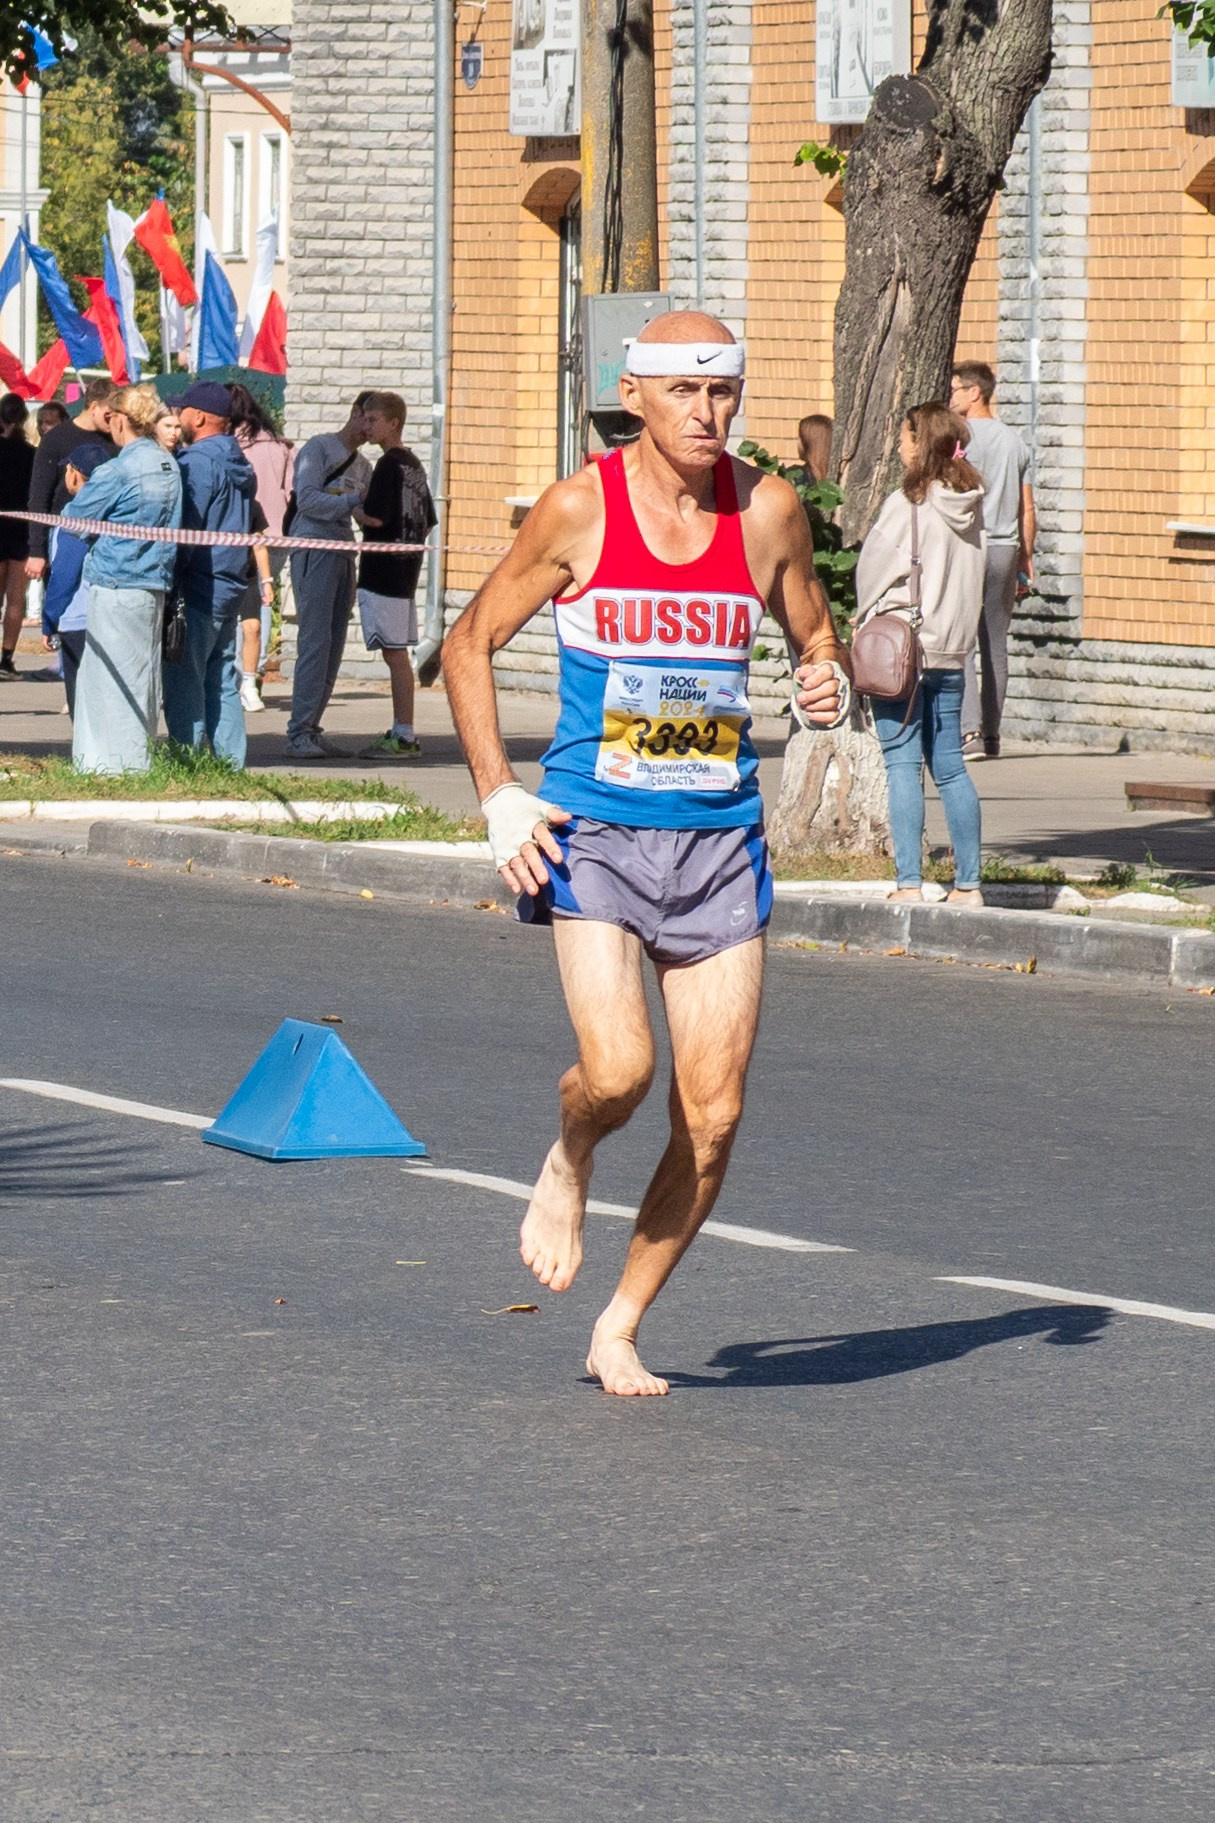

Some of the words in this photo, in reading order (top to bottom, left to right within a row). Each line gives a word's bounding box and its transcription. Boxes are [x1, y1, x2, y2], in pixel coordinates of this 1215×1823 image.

[594, 597, 751, 649] RUSSIA
[660, 674, 698, 688] КРОСС
[659, 688, 707, 702] НАЦИИ
[658, 700, 705, 717] 2024
[651, 775, 696, 786] ОБЛАСТЬ
